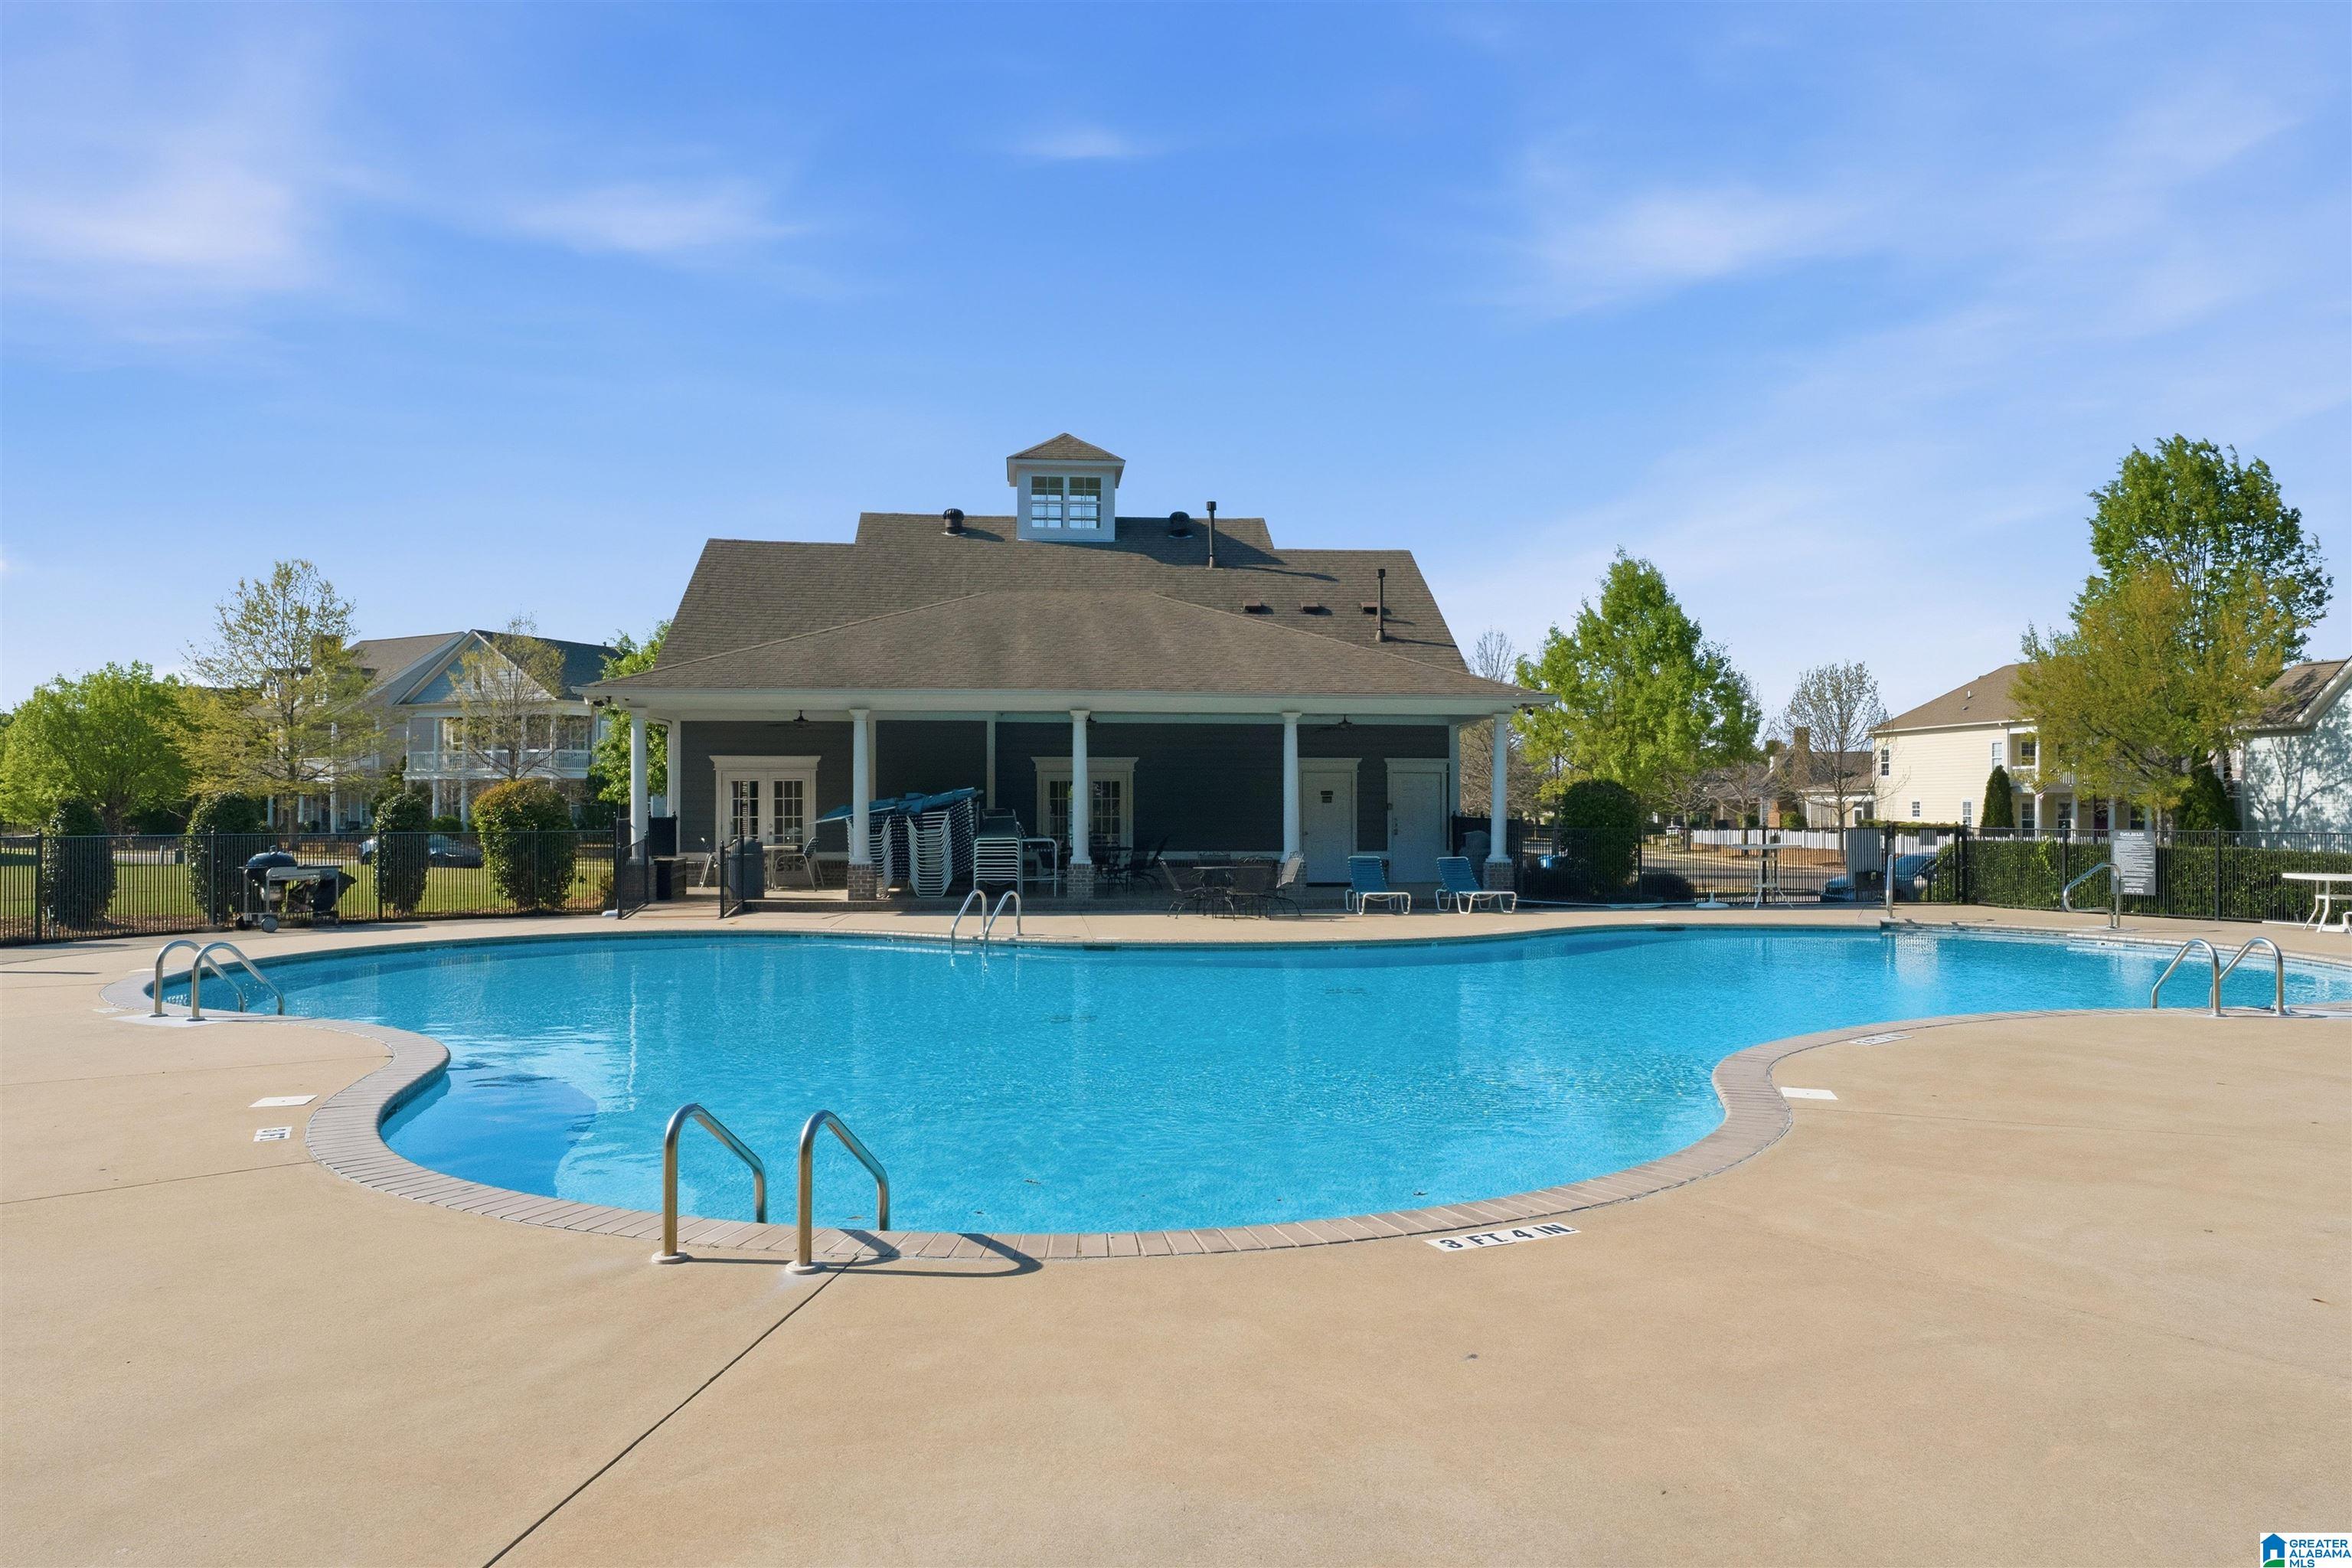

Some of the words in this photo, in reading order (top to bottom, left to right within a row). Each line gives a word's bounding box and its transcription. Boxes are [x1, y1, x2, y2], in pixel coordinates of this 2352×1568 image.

[1439, 1239, 1463, 1249] 3
[1465, 1233, 1508, 1245] FT.
[1511, 1229, 1534, 1239] 4
[1532, 1223, 1576, 1235] IN.
